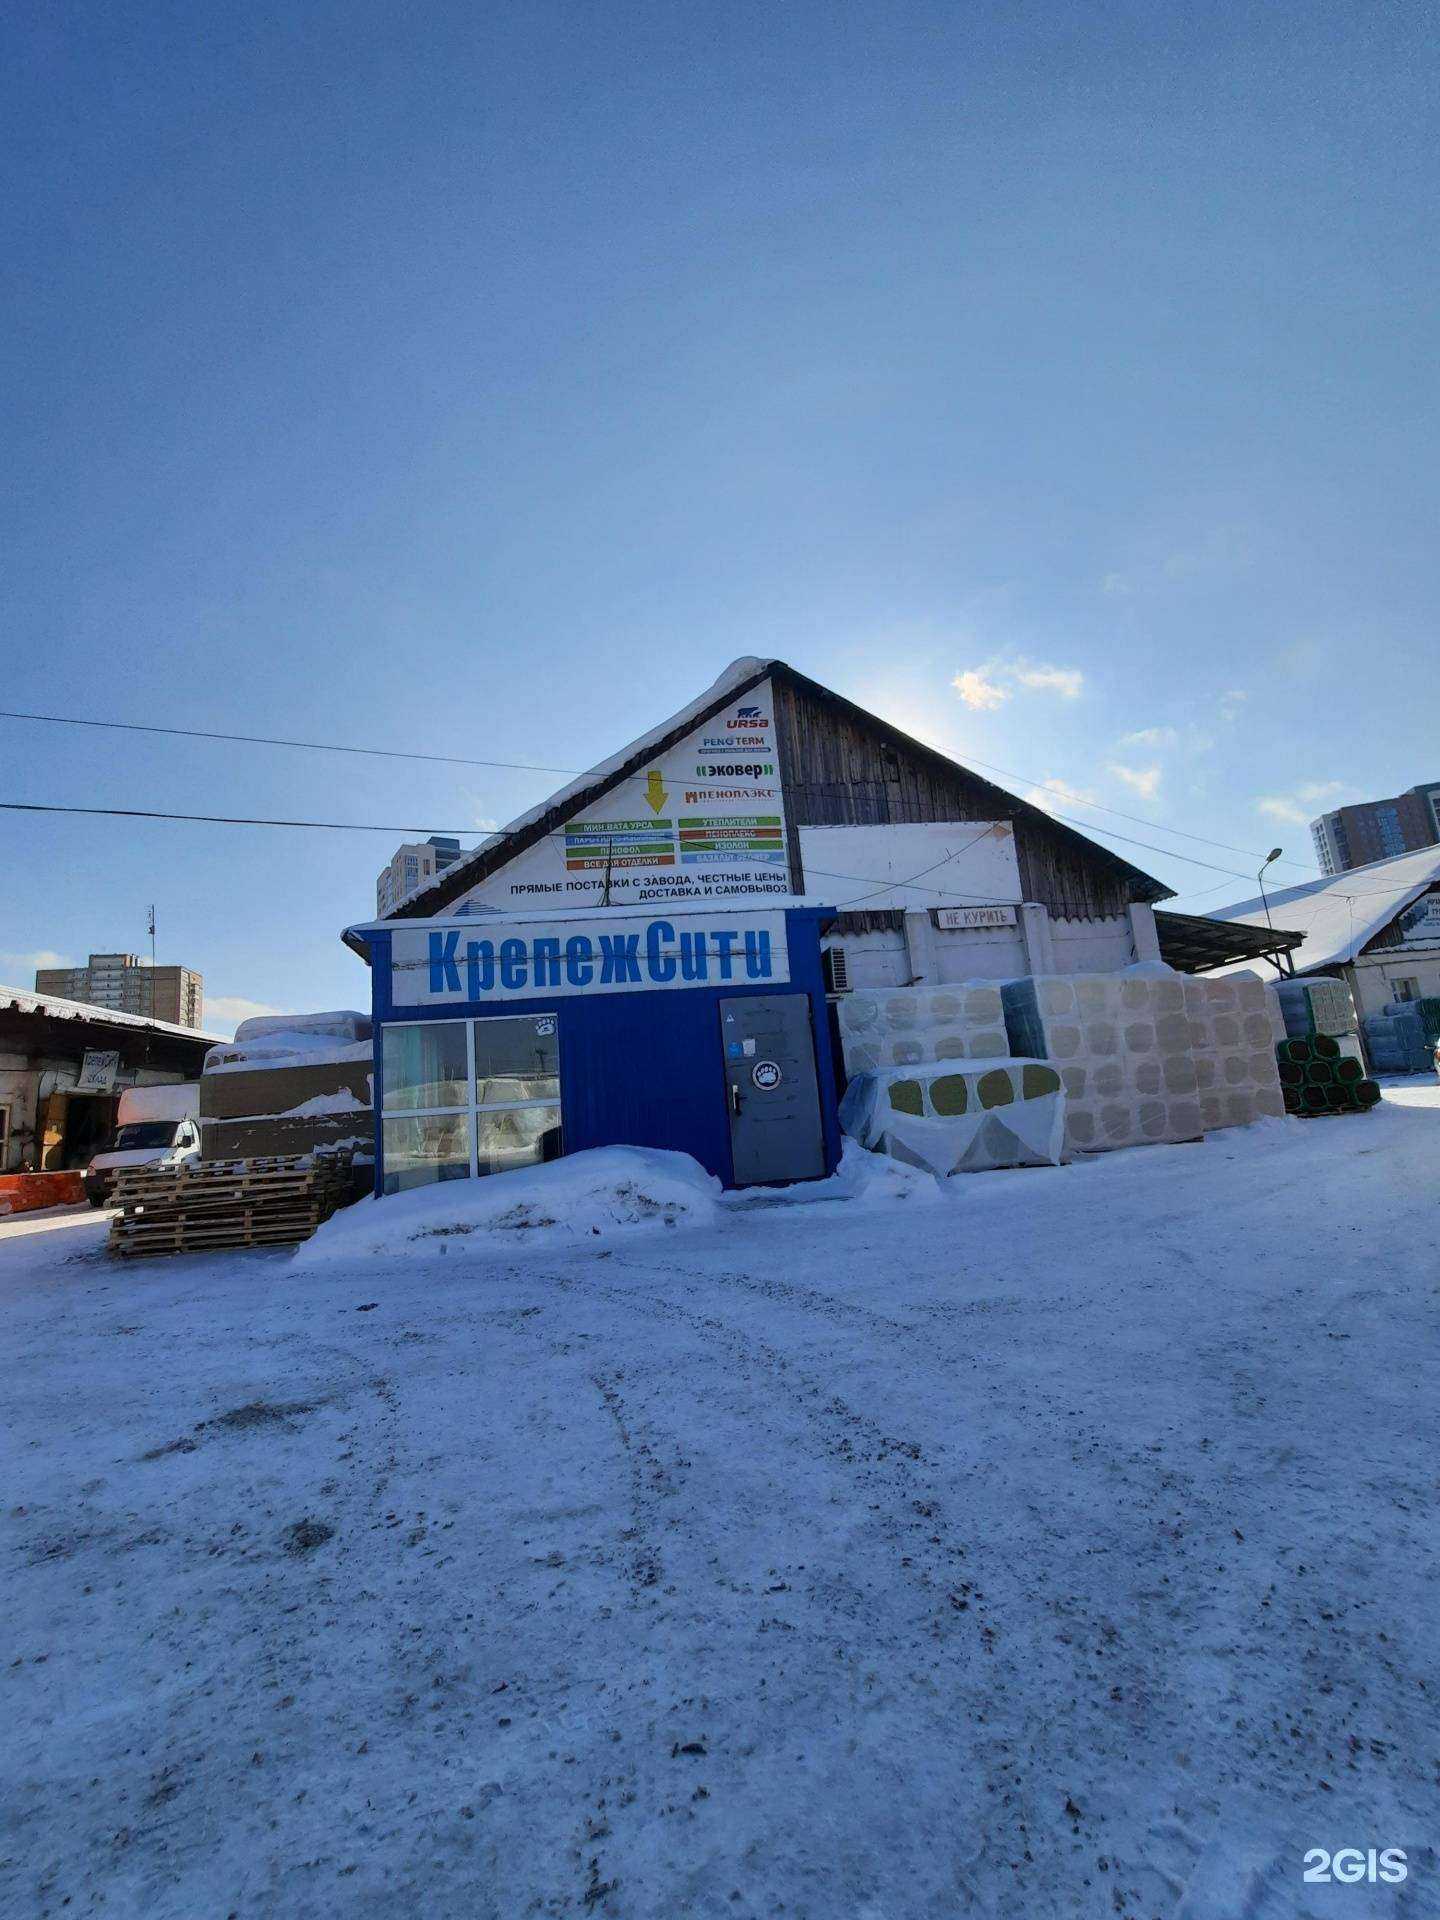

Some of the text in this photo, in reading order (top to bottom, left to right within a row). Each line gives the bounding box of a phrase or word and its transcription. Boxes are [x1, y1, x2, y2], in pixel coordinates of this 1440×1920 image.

[630, 821, 654, 830] УРСА
[702, 817, 758, 826] УТЕПЛИТЕЛИ
[715, 841, 750, 850] ИЗОЛОН
[584, 861, 601, 869] ВСЕ
[621, 857, 659, 867] ОТДЕЛКИ
[510, 872, 787, 895] ПРЯМЫЕ ПОСТАВКИ С ЗАВОДА, ЧЕСТНЫЕ ЦЕНЫ
[639, 884, 788, 900] ДОСТАВКА И САМОВЫВОЗ
[945, 912, 960, 925] НЕ
[428, 920, 773, 1001] КрепежСити
